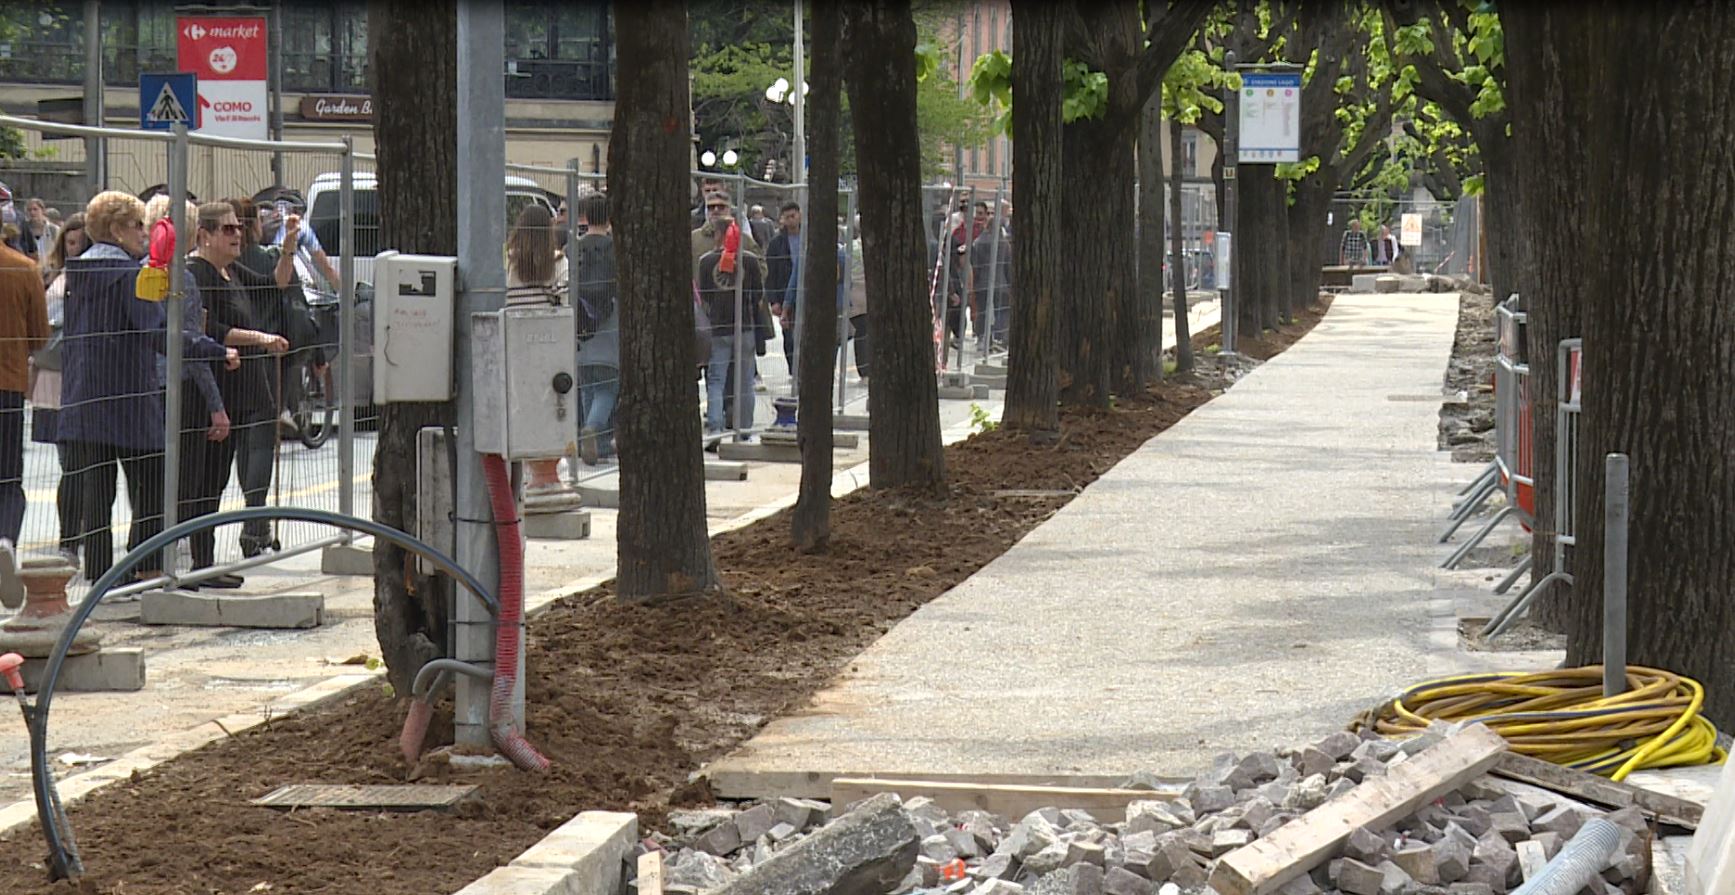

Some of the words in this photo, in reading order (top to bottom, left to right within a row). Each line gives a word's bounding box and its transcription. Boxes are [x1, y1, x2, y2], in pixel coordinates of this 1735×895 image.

[208, 24, 259, 39] market
[213, 101, 252, 112] COMO
[315, 98, 358, 117] Garden
